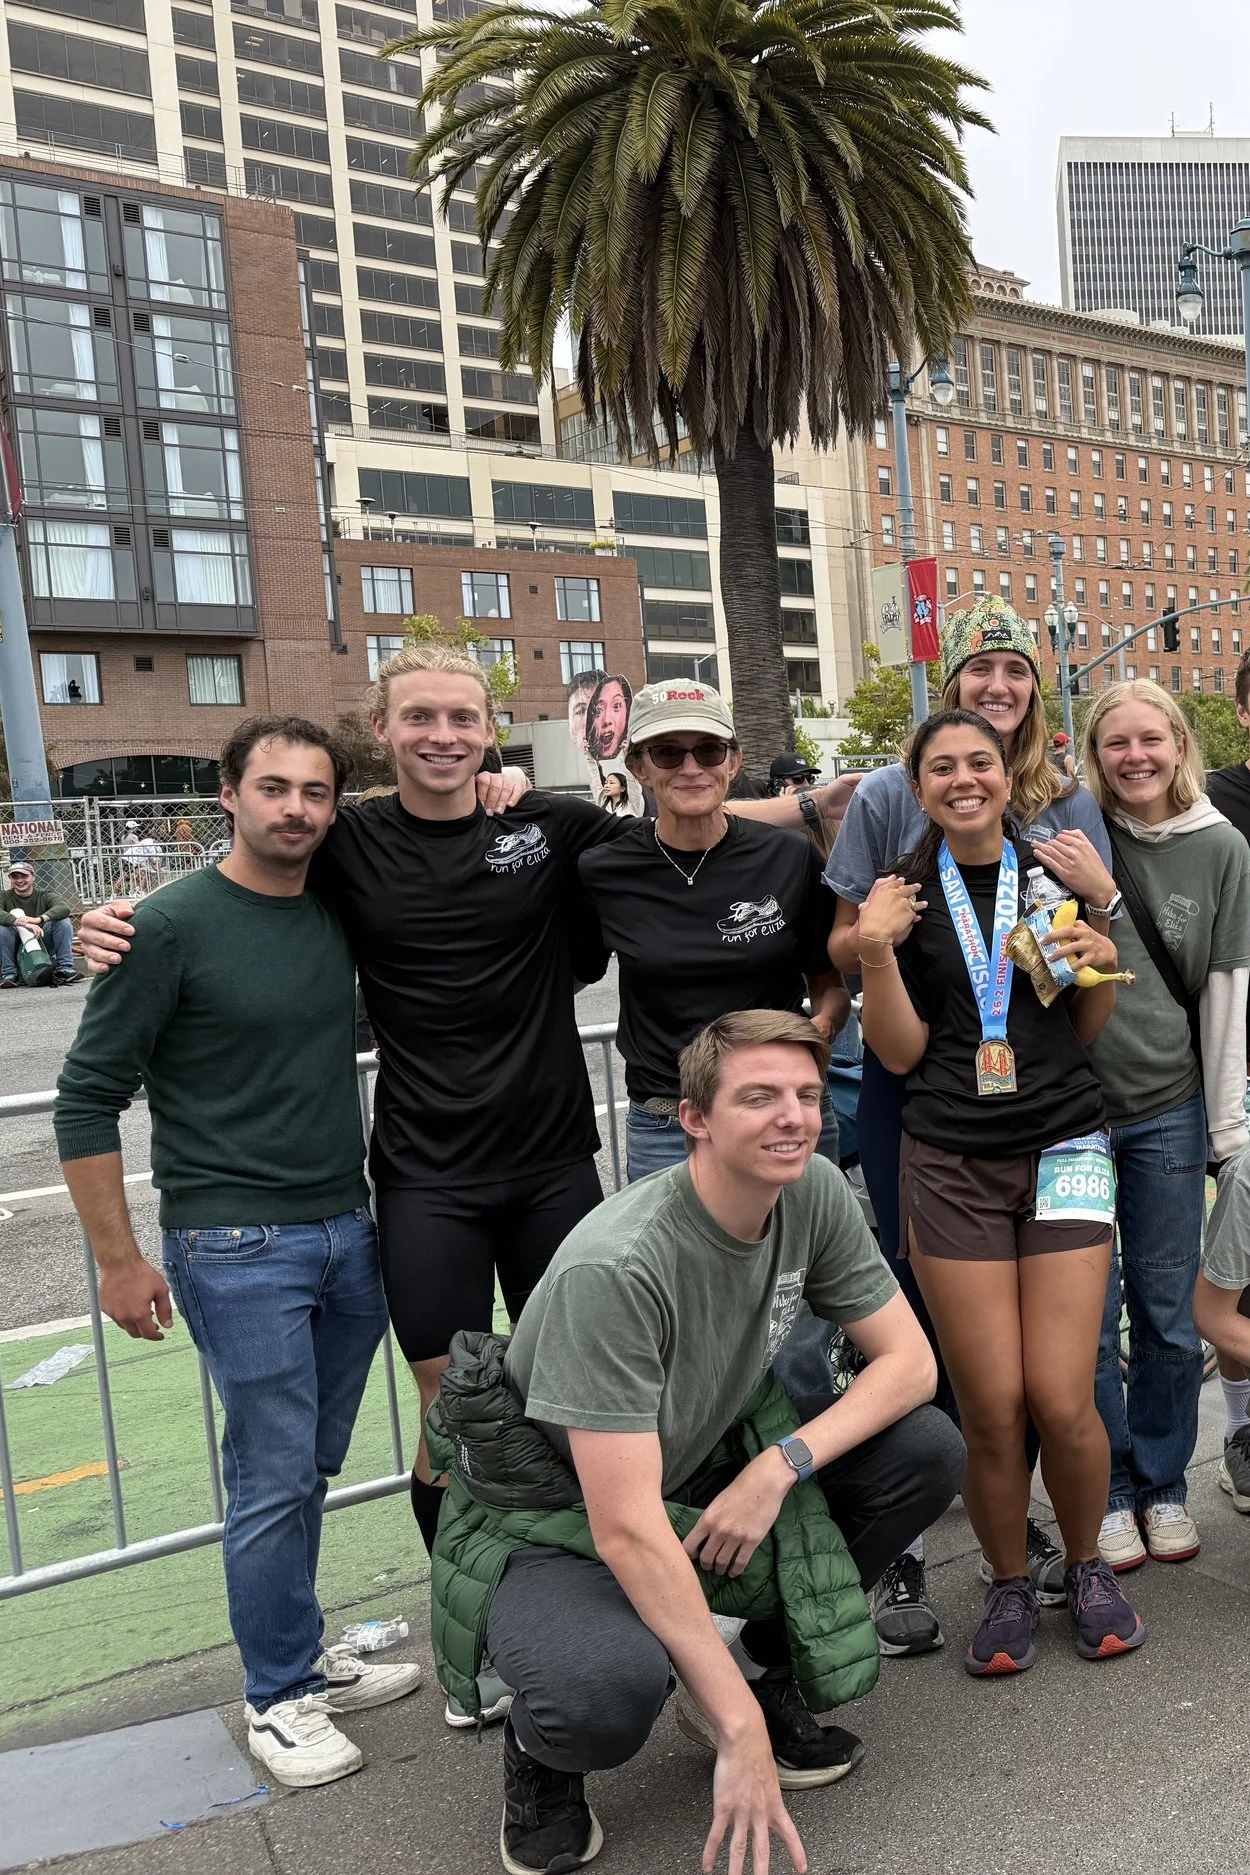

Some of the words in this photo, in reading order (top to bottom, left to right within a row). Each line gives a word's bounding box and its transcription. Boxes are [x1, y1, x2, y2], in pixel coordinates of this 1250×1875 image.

[1, 821, 61, 835] NATIONAL
[491, 864, 508, 873] run
[512, 857, 524, 875] for
[526, 846, 551, 866] eliza
[941, 866, 966, 904] SAN
[995, 869, 1018, 931] 2025
[722, 934, 742, 942] run
[744, 927, 758, 943] for
[761, 919, 786, 936] eliza
[960, 910, 979, 957] MARATHON
[996, 932, 1010, 986] FINISER
[992, 989, 1004, 1017] 26.2
[1054, 1166, 1073, 1174] RUN
[1074, 1165, 1093, 1173] FOR
[1093, 1166, 1110, 1177] ELIZA
[1055, 1174, 1110, 1200] 6986
